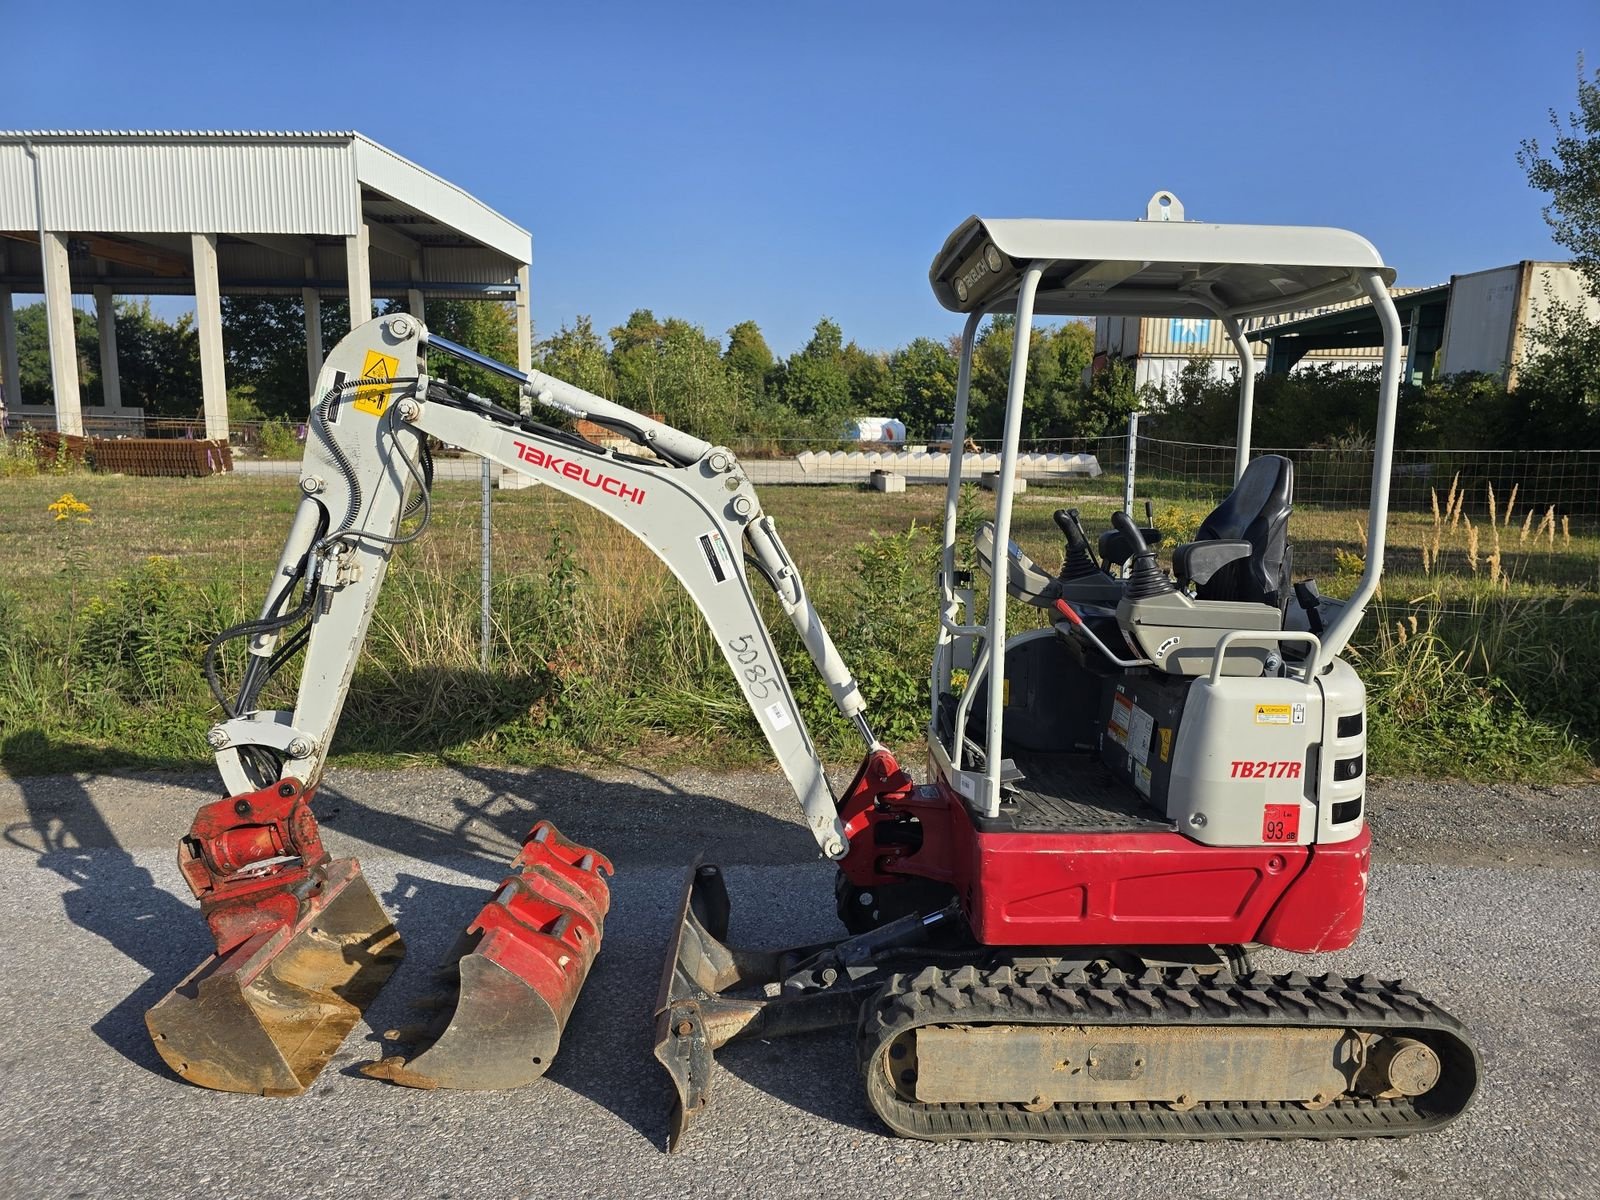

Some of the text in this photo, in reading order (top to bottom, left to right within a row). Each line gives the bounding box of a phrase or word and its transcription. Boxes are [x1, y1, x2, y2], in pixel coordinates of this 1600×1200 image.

[513, 441, 646, 505] TAKEUCHI
[728, 634, 781, 699] 5085
[1231, 761, 1301, 778] TB217R
[1267, 821, 1296, 840] 93 dB
